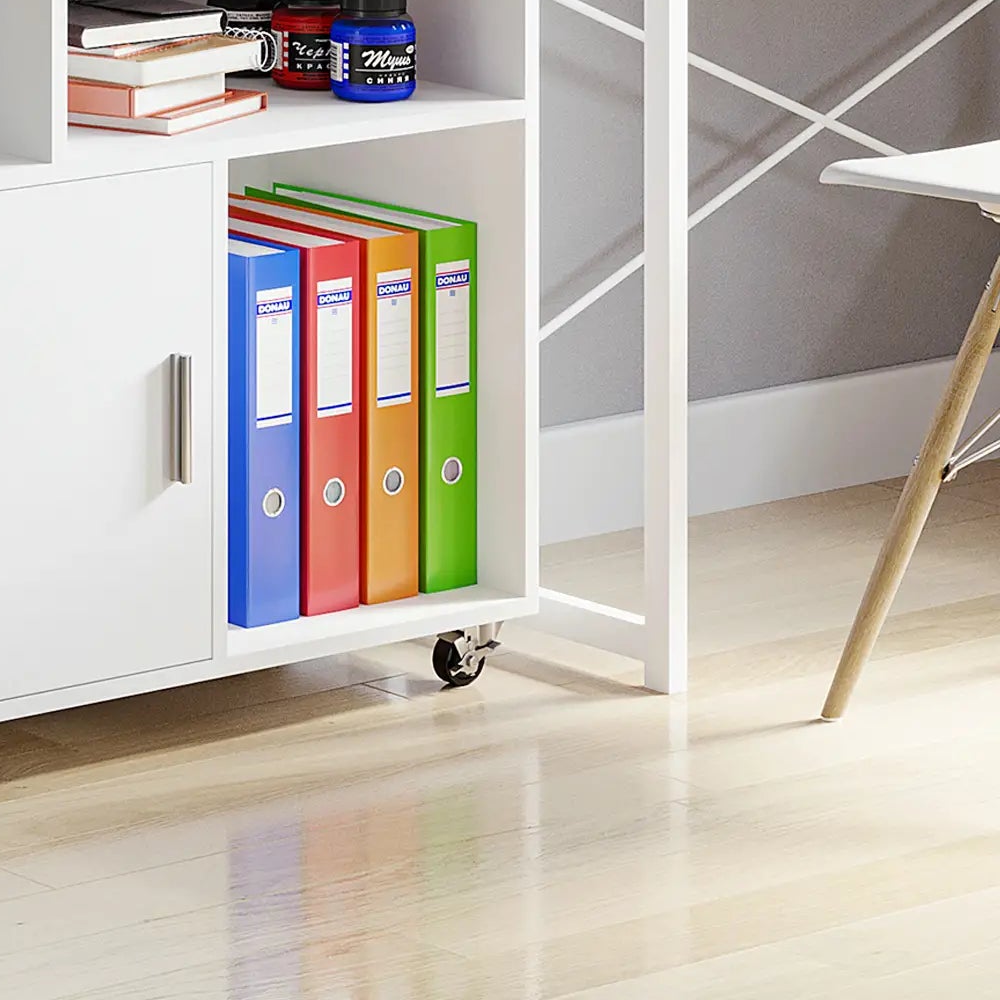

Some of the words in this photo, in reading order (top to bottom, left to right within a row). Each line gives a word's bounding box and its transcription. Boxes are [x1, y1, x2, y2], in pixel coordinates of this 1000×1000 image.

[437, 274, 467, 286] DONAU
[378, 283, 409, 295] DONAU
[319, 292, 350, 304] DONAU
[258, 301, 290, 314] DONAU
